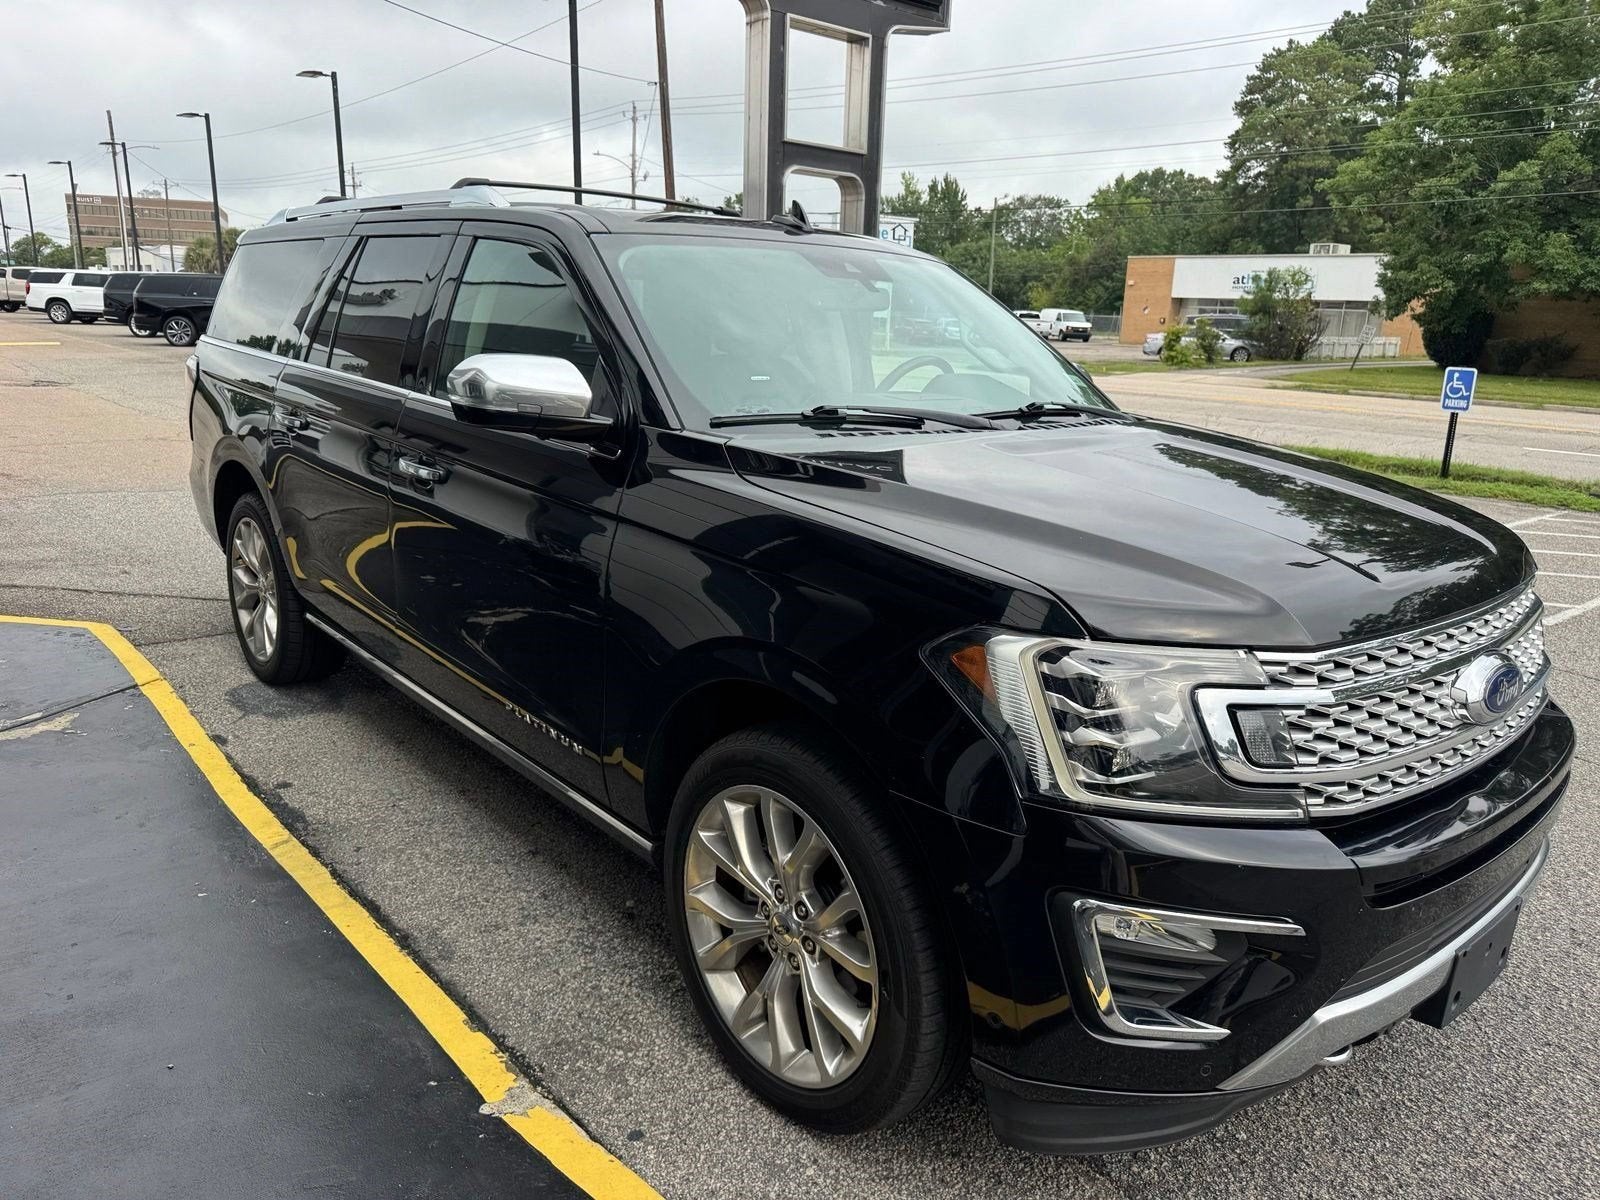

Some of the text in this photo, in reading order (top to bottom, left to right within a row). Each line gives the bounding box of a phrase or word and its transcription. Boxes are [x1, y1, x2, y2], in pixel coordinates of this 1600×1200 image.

[1444, 398, 1468, 408] PARKING
[1496, 673, 1520, 706] Ford
[505, 702, 583, 756] PLATINUM
